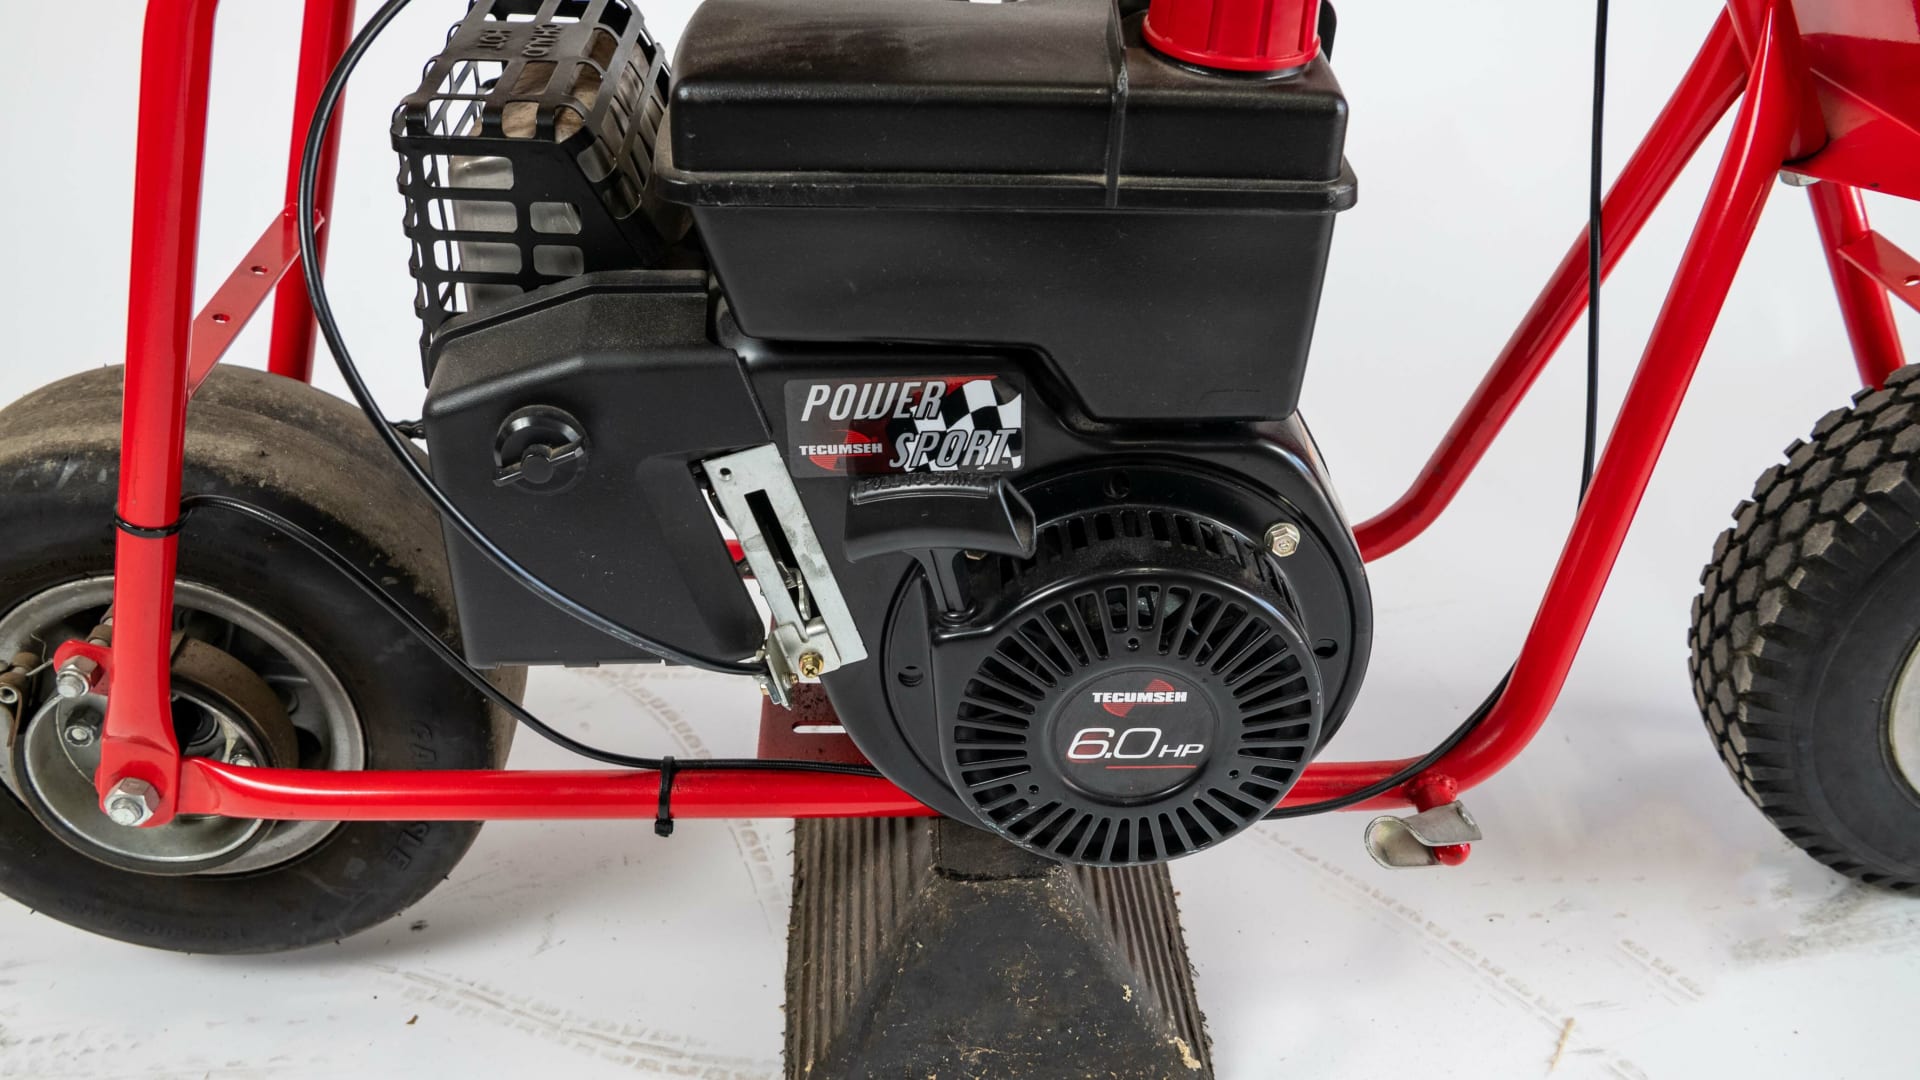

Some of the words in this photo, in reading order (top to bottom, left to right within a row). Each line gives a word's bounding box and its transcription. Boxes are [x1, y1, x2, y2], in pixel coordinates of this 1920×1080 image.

[477, 28, 512, 50] HOT
[800, 380, 947, 422] POWER
[799, 442, 883, 456] TECUMSEH
[889, 427, 1017, 470] SPORT
[1092, 691, 1188, 703] TECUMSEH
[1067, 727, 1162, 760] 6.0
[1158, 743, 1205, 758] HP
